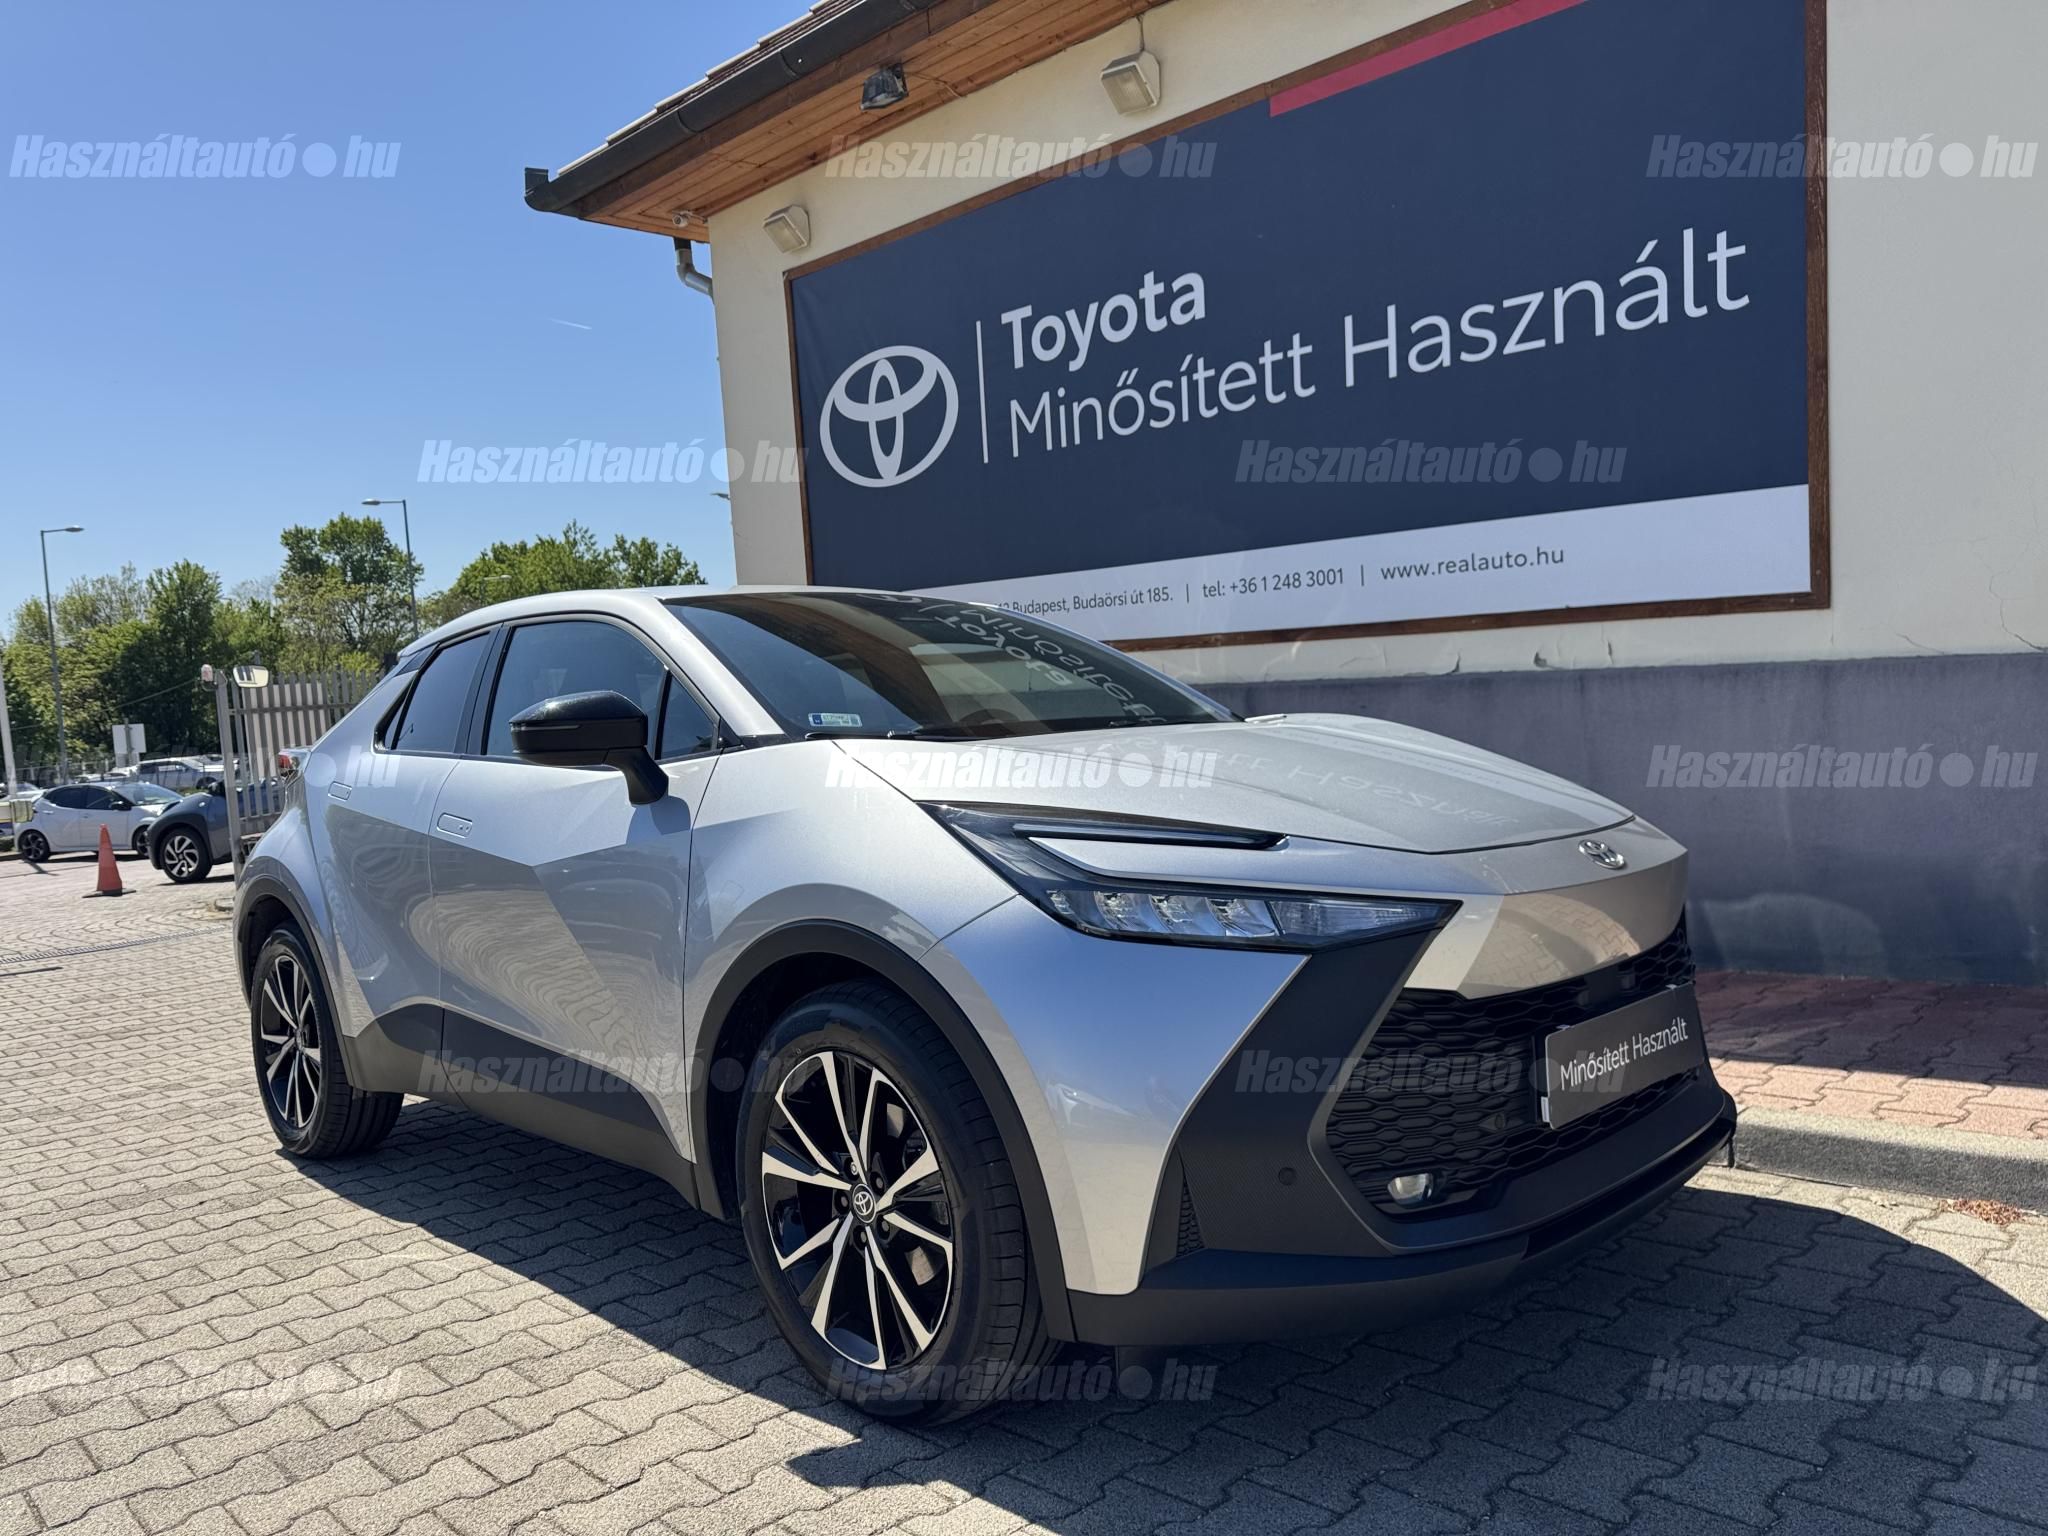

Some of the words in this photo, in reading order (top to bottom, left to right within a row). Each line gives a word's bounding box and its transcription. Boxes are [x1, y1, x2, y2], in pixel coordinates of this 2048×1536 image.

[1000, 270, 1206, 371] Toyota
[1008, 332, 1317, 458] Minősített
[1343, 227, 1750, 388] Használt
[1073, 590, 1128, 610] Budaörsi
[1130, 589, 1145, 604] út
[1147, 586, 1174, 603] 185.
[1202, 580, 1226, 598] tel:
[1272, 571, 1302, 591] 248
[1306, 567, 1344, 588] 3001
[1380, 546, 1565, 580] www.realauto.hu
[1560, 1041, 1630, 1092] Minősített
[1632, 1016, 1689, 1060] Használt
